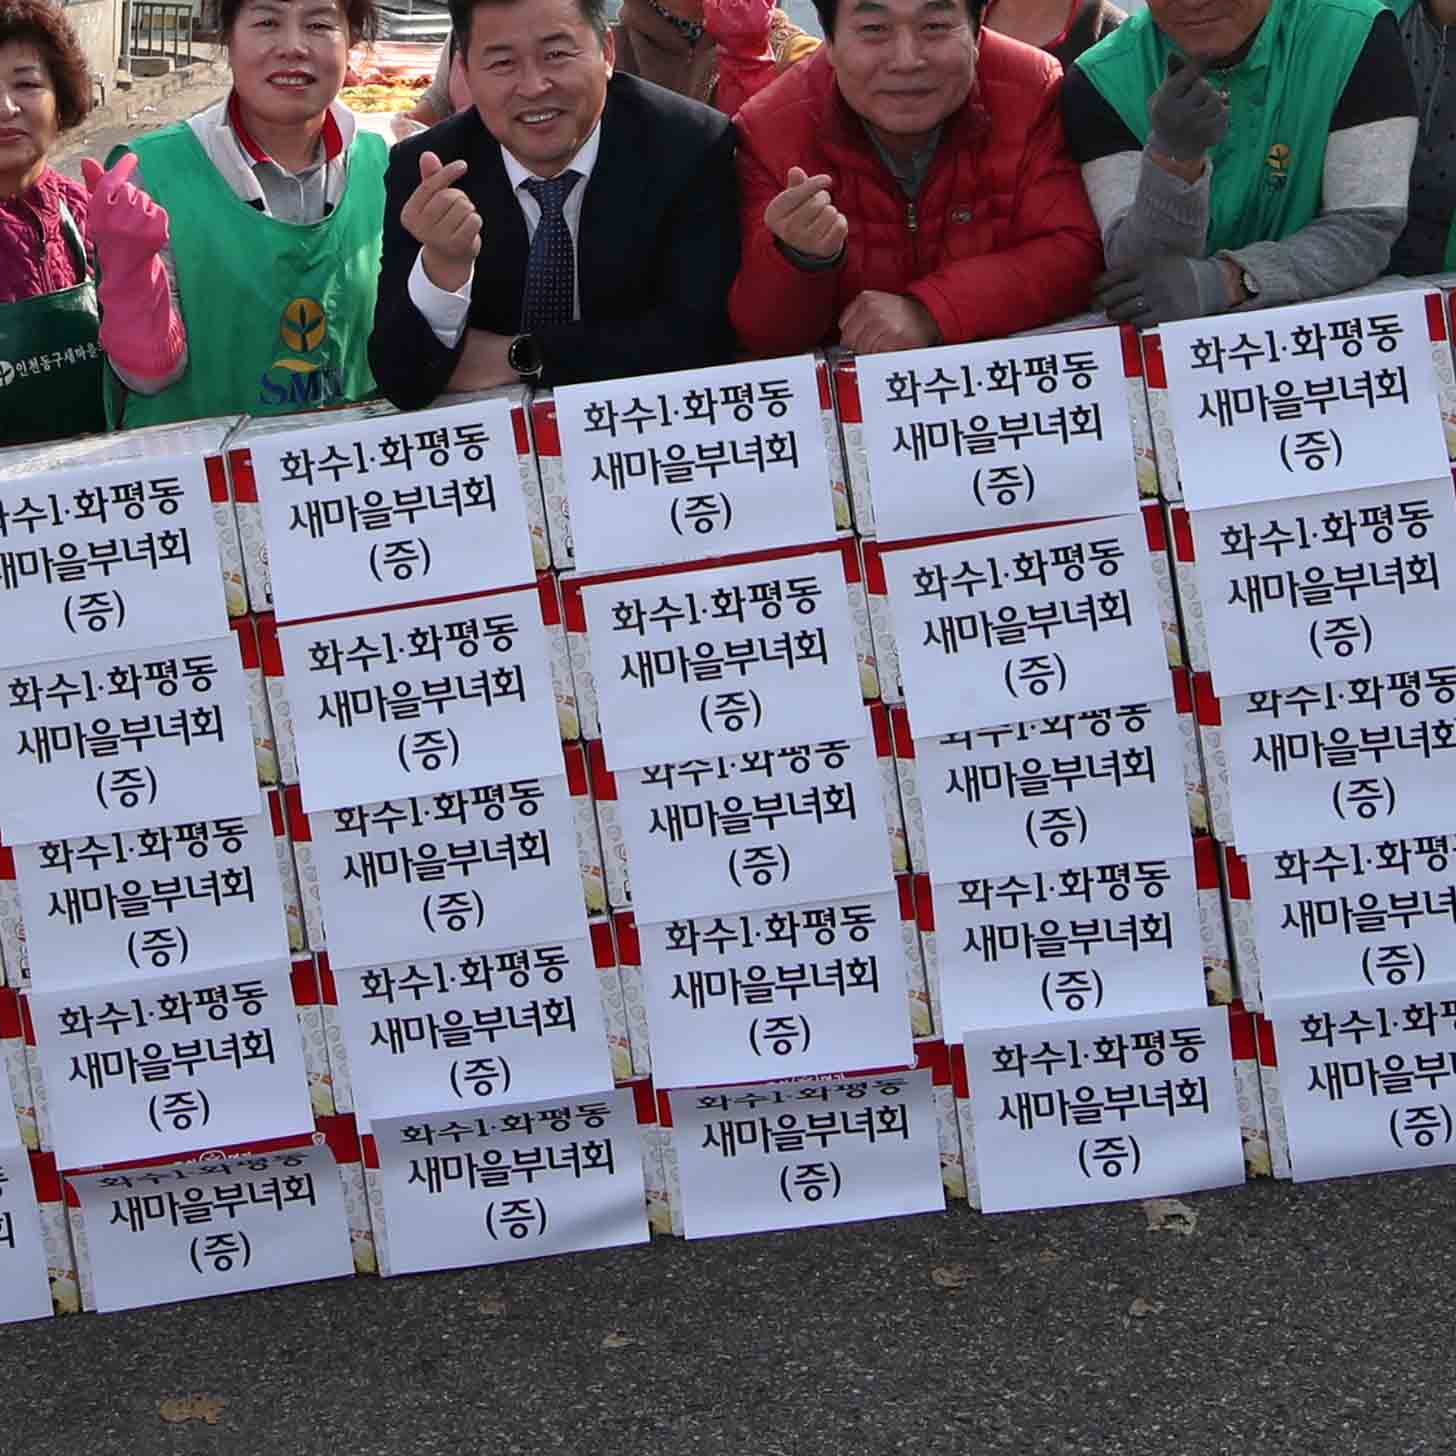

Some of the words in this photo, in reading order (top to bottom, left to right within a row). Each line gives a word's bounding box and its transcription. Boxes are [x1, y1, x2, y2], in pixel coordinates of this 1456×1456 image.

[1197, 365, 1409, 428] 새마을부녀회
[892, 402, 1103, 462] 새마을부녀회
[591, 430, 799, 491] 새마을부녀회
[289, 473, 497, 539] 새마을부녀회
[670, 492, 732, 536] (증)
[1227, 551, 1440, 614] 새마을부녀회
[64, 590, 125, 633] (증)
[922, 588, 1133, 655] 새마을부녀회
[1310, 614, 1372, 659] (증)
[620, 626, 828, 689] 새마을부녀회
[317, 664, 526, 729] 새마을부녀회
[700, 689, 762, 733] (증)
[16, 704, 225, 765] 새마을부녀회
[398, 727, 459, 773] (증)
[945, 744, 1156, 804] 새마을부녀회
[1333, 776, 1396, 820] (증)
[648, 781, 857, 843] 새마을부녀회
[343, 828, 551, 889] 새마을부녀회
[728, 843, 790, 887] (증)
[47, 865, 255, 926] 새마을부녀회
[423, 889, 484, 933] (증)
[962, 911, 1173, 963] 새마을부녀회
[1362, 943, 1425, 986] (증)
[670, 954, 879, 1010] 새마을부녀회
[1041, 969, 1103, 1011] (증)
[369, 994, 577, 1055] 새마을부녀회
[68, 1027, 276, 1091] 새마을부녀회
[450, 1055, 511, 1098] (증)
[701, 1103, 909, 1158] 새마을부녀회
[997, 1075, 1210, 1131] 새마을부녀회
[1390, 1103, 1453, 1149] (증)
[407, 1137, 615, 1195] 새마을부녀회
[780, 1161, 841, 1203] (증)
[109, 1171, 317, 1233] 새마을부녀회
[486, 1197, 547, 1241] (증)
